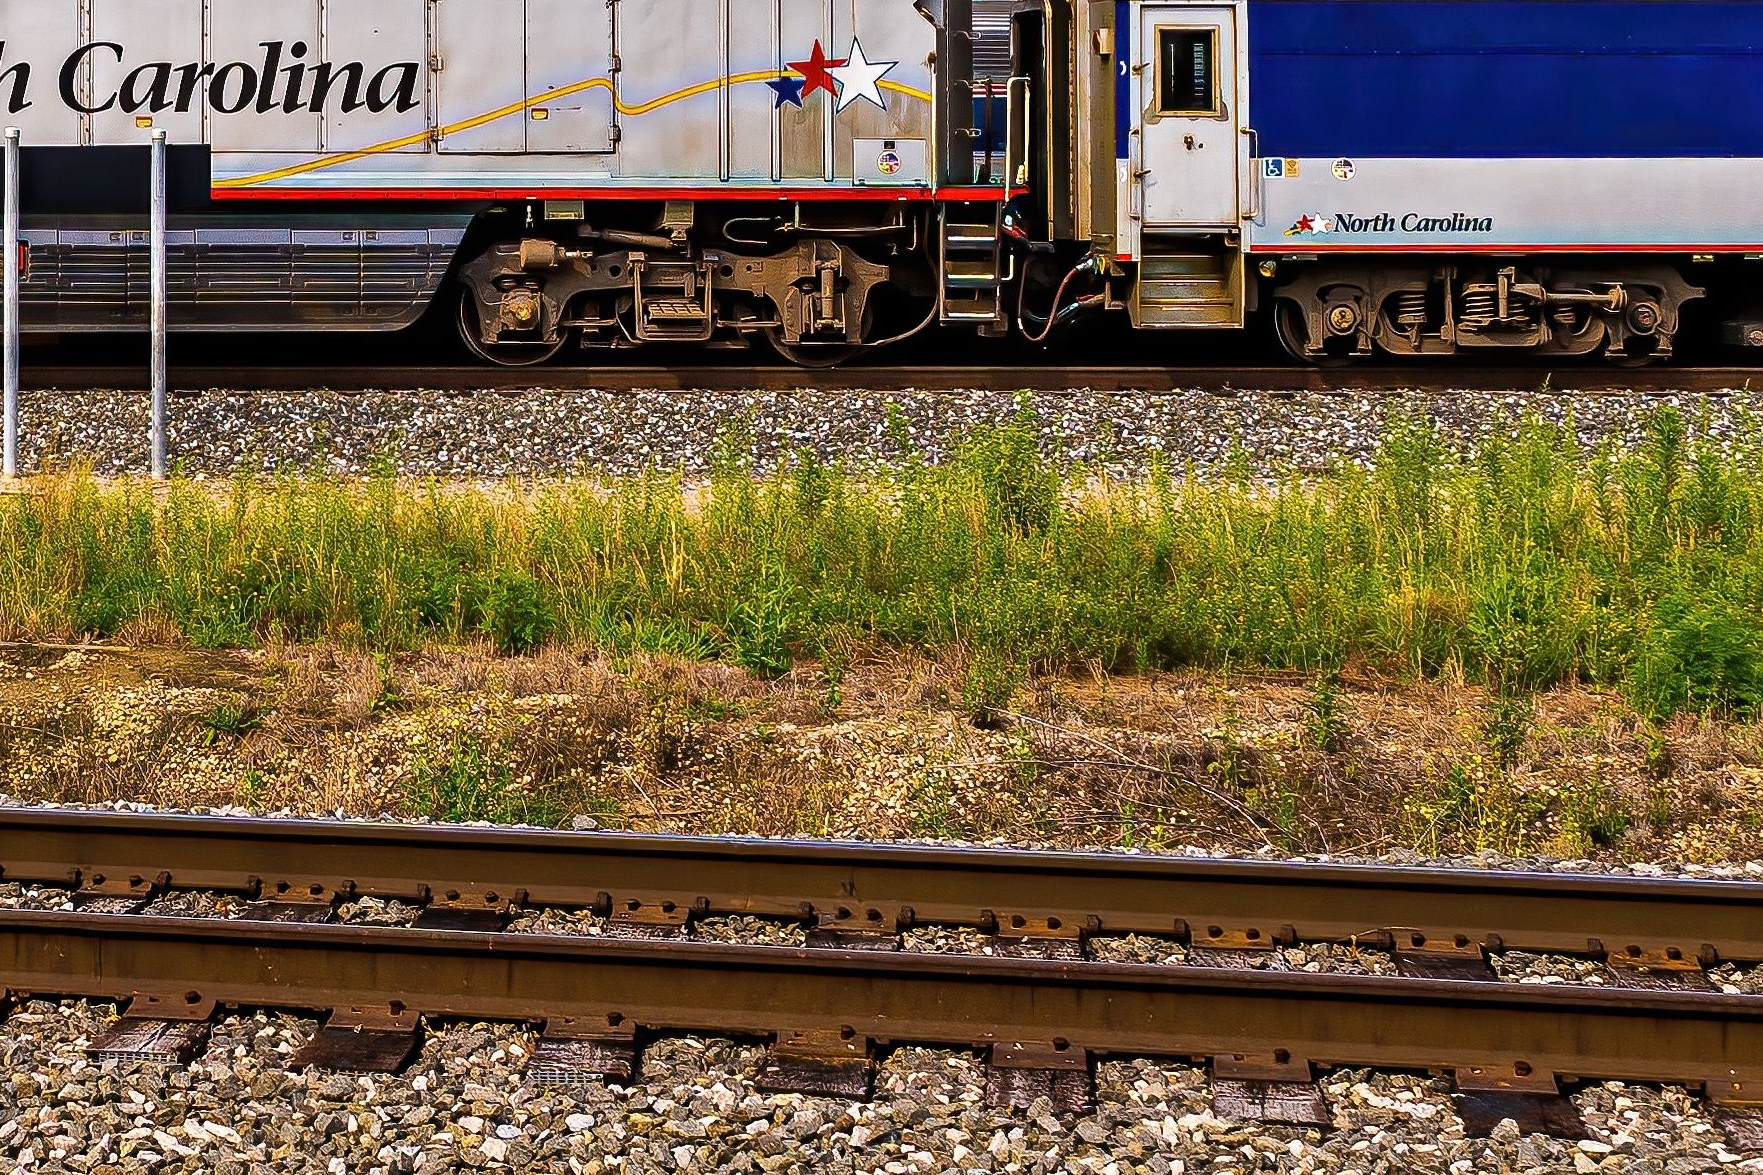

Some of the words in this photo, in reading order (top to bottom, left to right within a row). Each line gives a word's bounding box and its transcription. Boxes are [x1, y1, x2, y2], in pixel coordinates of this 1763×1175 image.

[59, 40, 421, 114] Carolina
[1334, 212, 1396, 233] North
[1400, 212, 1493, 233] Carolina
